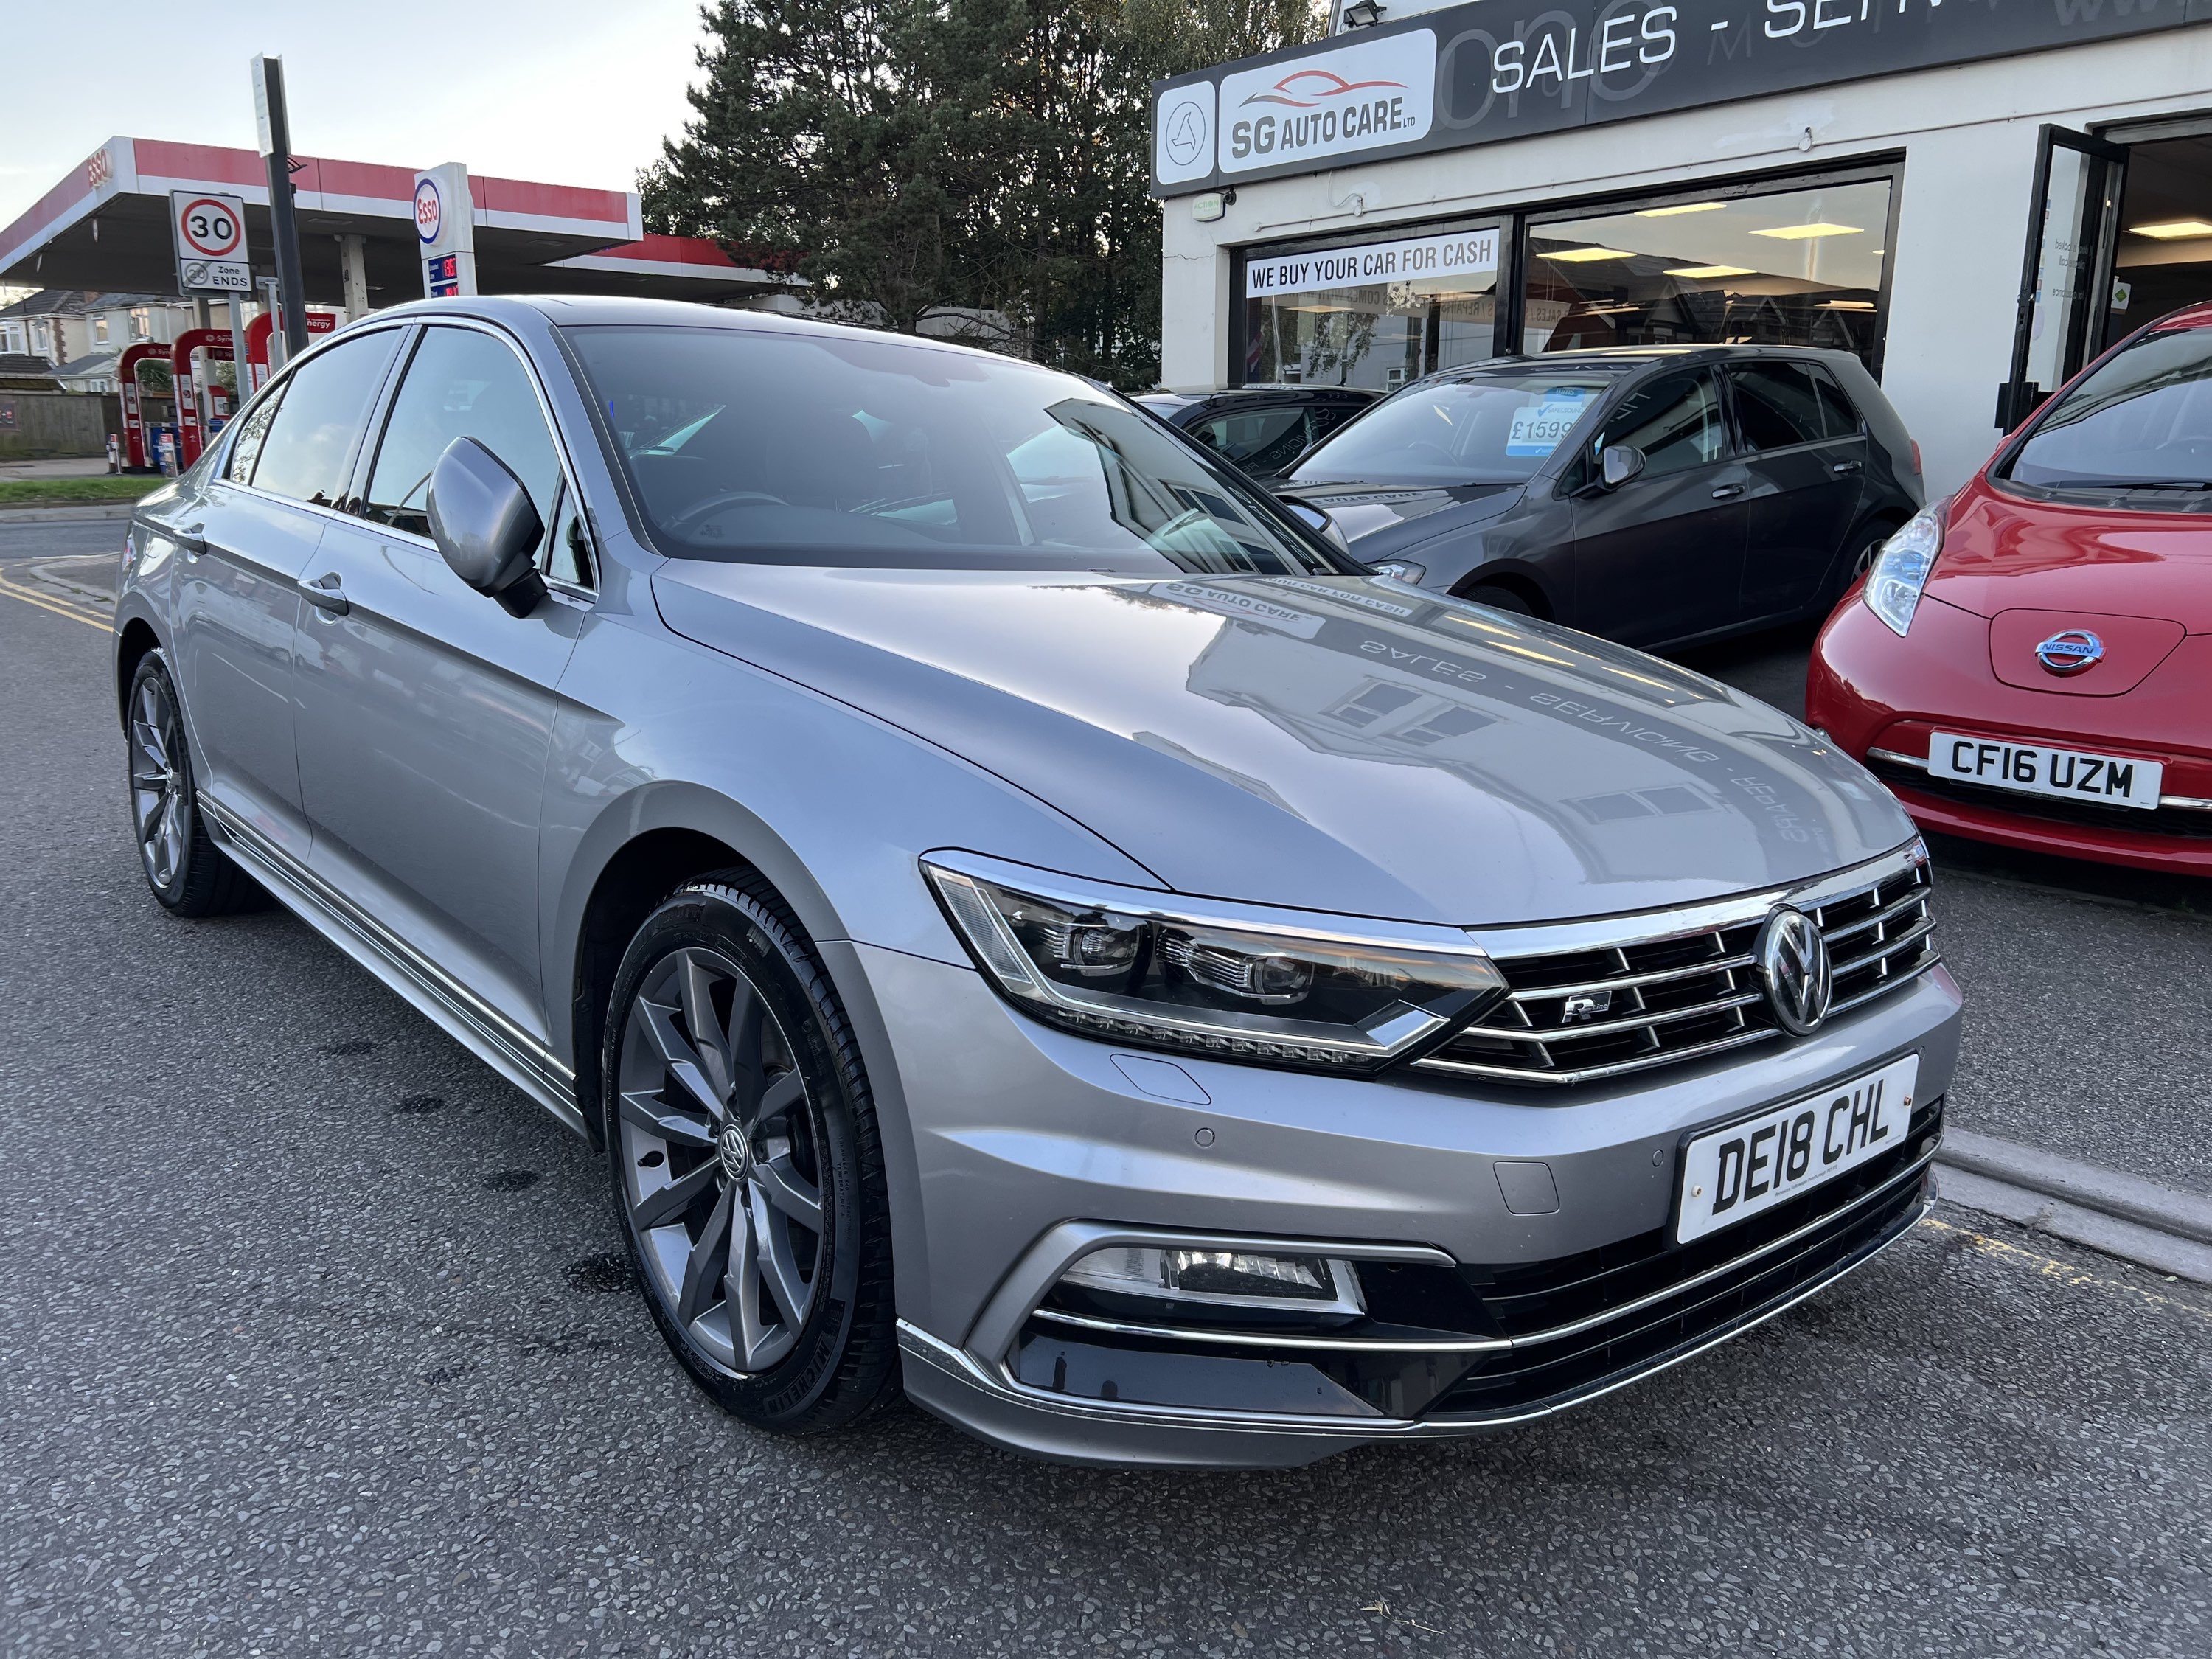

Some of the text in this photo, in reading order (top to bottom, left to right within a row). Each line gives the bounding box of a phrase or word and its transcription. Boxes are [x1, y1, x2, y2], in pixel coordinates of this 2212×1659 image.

[1492, 6, 1677, 94] SALES
[1232, 97, 1416, 159] SG AUTO CARE LTD
[190, 215, 232, 240] 30
[417, 198, 437, 225] Esso
[189, 269, 205, 279] 20
[212, 276, 248, 287] ENDS
[218, 265, 240, 274] Zone
[1252, 239, 1492, 288] WE BUY YOUR CAR FOR CASH
[2042, 642, 2095, 655] NISSAN
[1952, 740, 2135, 799] CF16 UZM
[1712, 1079, 1889, 1216] DE18 CHL
[767, 1340, 832, 1413] MICHELIN
